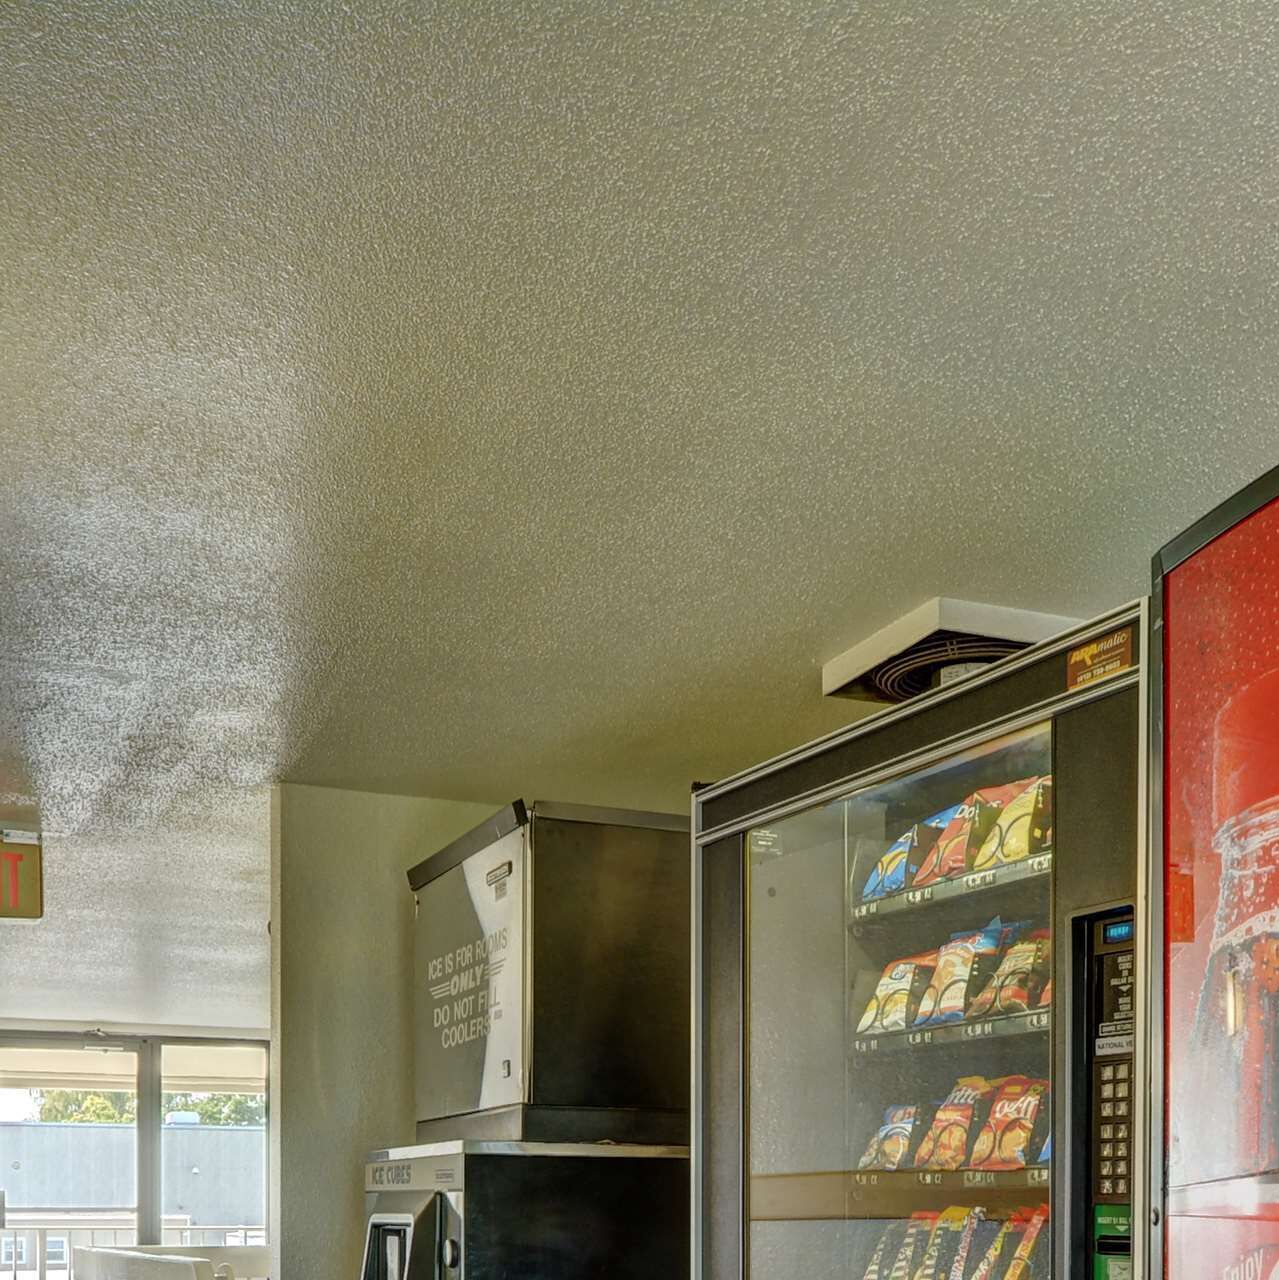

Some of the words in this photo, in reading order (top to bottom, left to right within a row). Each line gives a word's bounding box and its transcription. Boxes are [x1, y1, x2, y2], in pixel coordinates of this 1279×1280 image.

[428, 957, 442, 980] ICE
[445, 952, 453, 975] IS
[456, 943, 472, 970] FOR
[476, 927, 508, 961] ROOMS
[450, 963, 484, 996] ONLY
[434, 1004, 450, 1028] DO
[454, 995, 475, 1021] NOT
[441, 1015, 491, 1048] COOLERS
